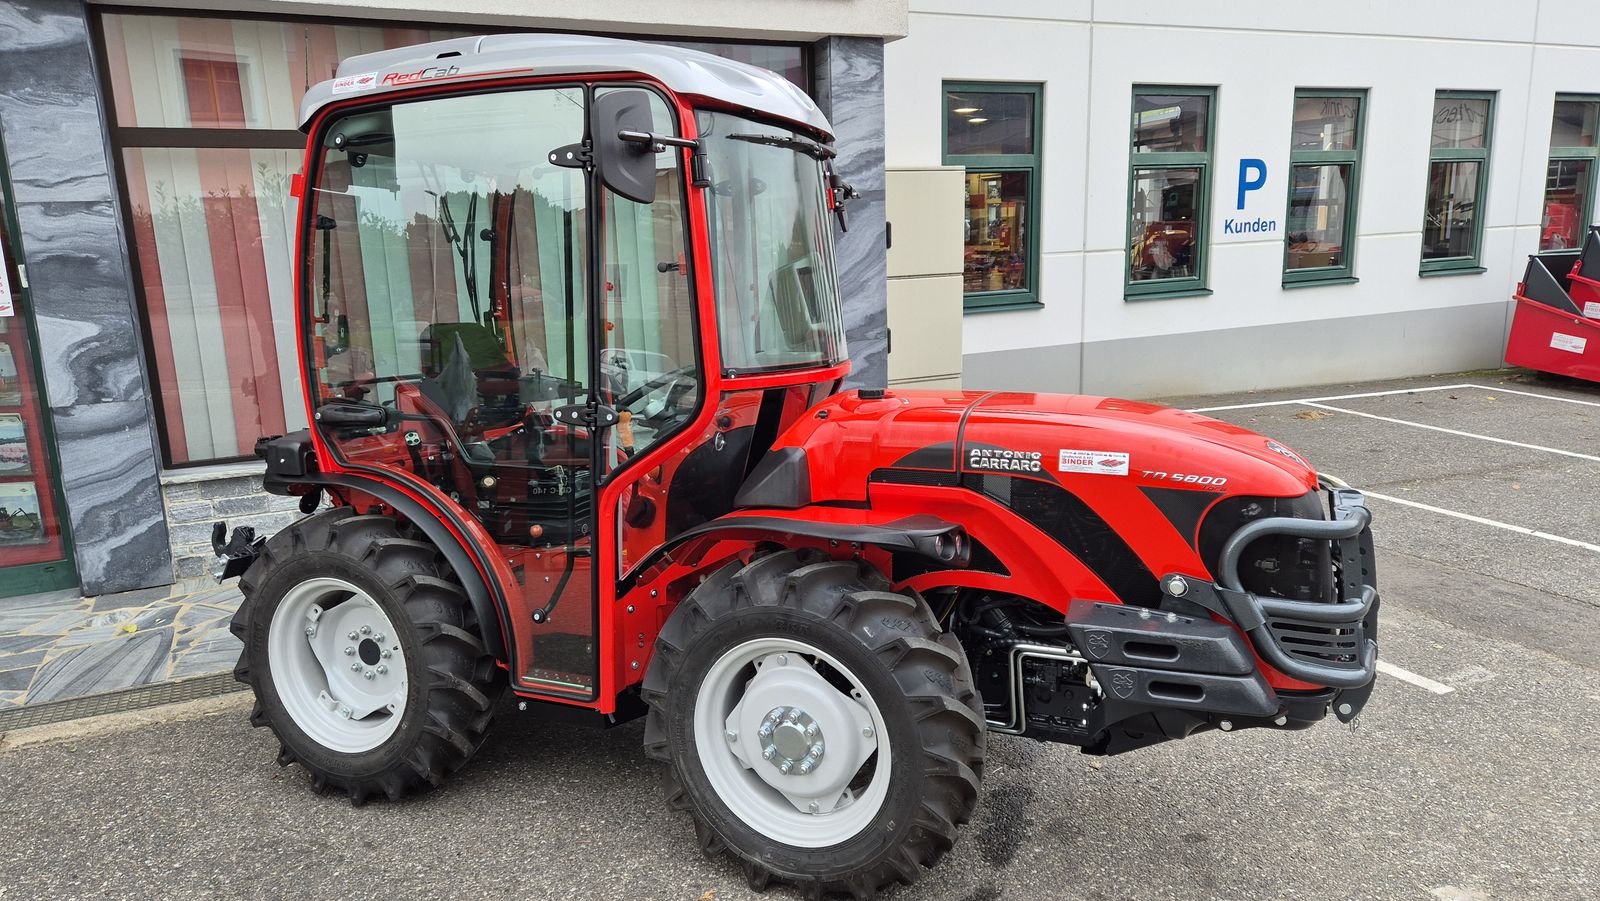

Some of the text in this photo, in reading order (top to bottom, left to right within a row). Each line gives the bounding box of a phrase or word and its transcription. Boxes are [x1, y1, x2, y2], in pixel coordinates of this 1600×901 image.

[382, 65, 460, 86] RedCab
[1237, 158, 1267, 210] P
[1224, 217, 1276, 234] Kunden
[970, 448, 1042, 459] ANTONIO
[970, 457, 1042, 472] CARRARO
[1062, 457, 1094, 466] BINDER
[1171, 473, 1228, 486] 5800
